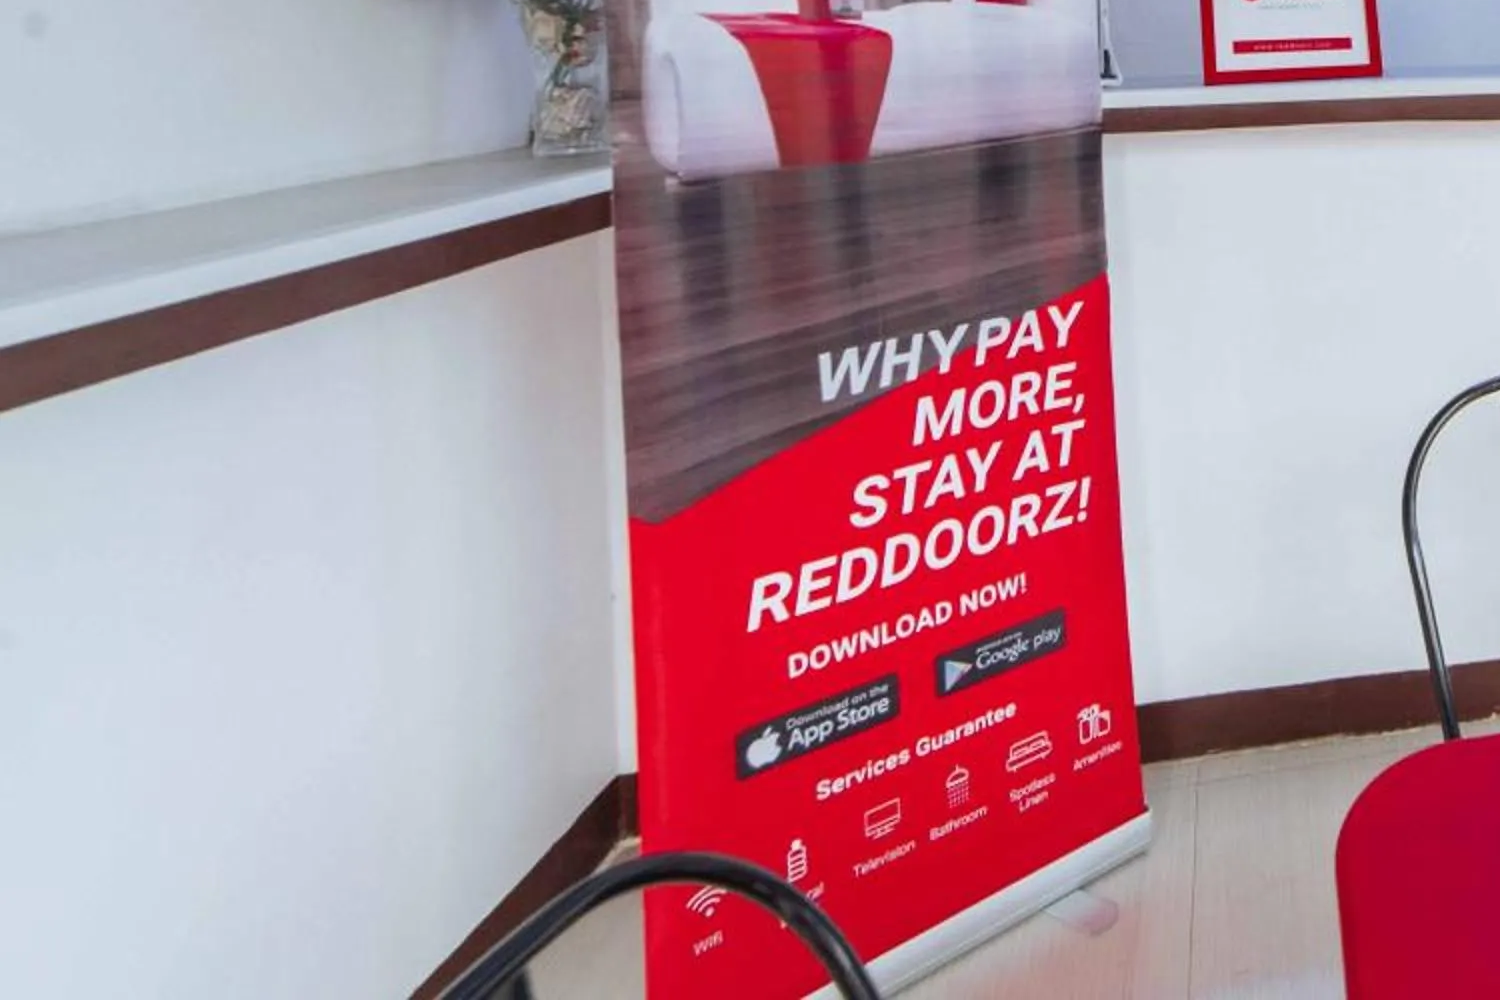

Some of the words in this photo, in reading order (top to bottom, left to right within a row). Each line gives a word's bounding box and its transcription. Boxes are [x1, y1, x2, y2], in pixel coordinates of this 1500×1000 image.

[817, 323, 969, 402] WHY
[974, 301, 1084, 367] PAY
[911, 362, 1085, 447] MORE,
[849, 441, 1003, 528] STAY
[1012, 419, 1085, 481] AT
[746, 477, 1092, 633] REDDOORZ!
[787, 600, 953, 679] DOWNLOAD
[960, 572, 1027, 617] NOW!
[976, 638, 1030, 669] Google
[1034, 627, 1060, 650] play
[785, 696, 850, 730] Download
[851, 691, 867, 704] on
[868, 684, 889, 698] the
[788, 719, 833, 750] App
[837, 697, 889, 731] Store
[815, 746, 911, 801] Services
[916, 702, 1018, 759] Guarantee
[1073, 740, 1123, 772] Amenities
[1009, 773, 1056, 802] Spotless
[1019, 791, 1049, 813] Linen
[930, 805, 988, 841] Bathroom
[853, 840, 916, 877] Television
[693, 930, 724, 956] Wifi
